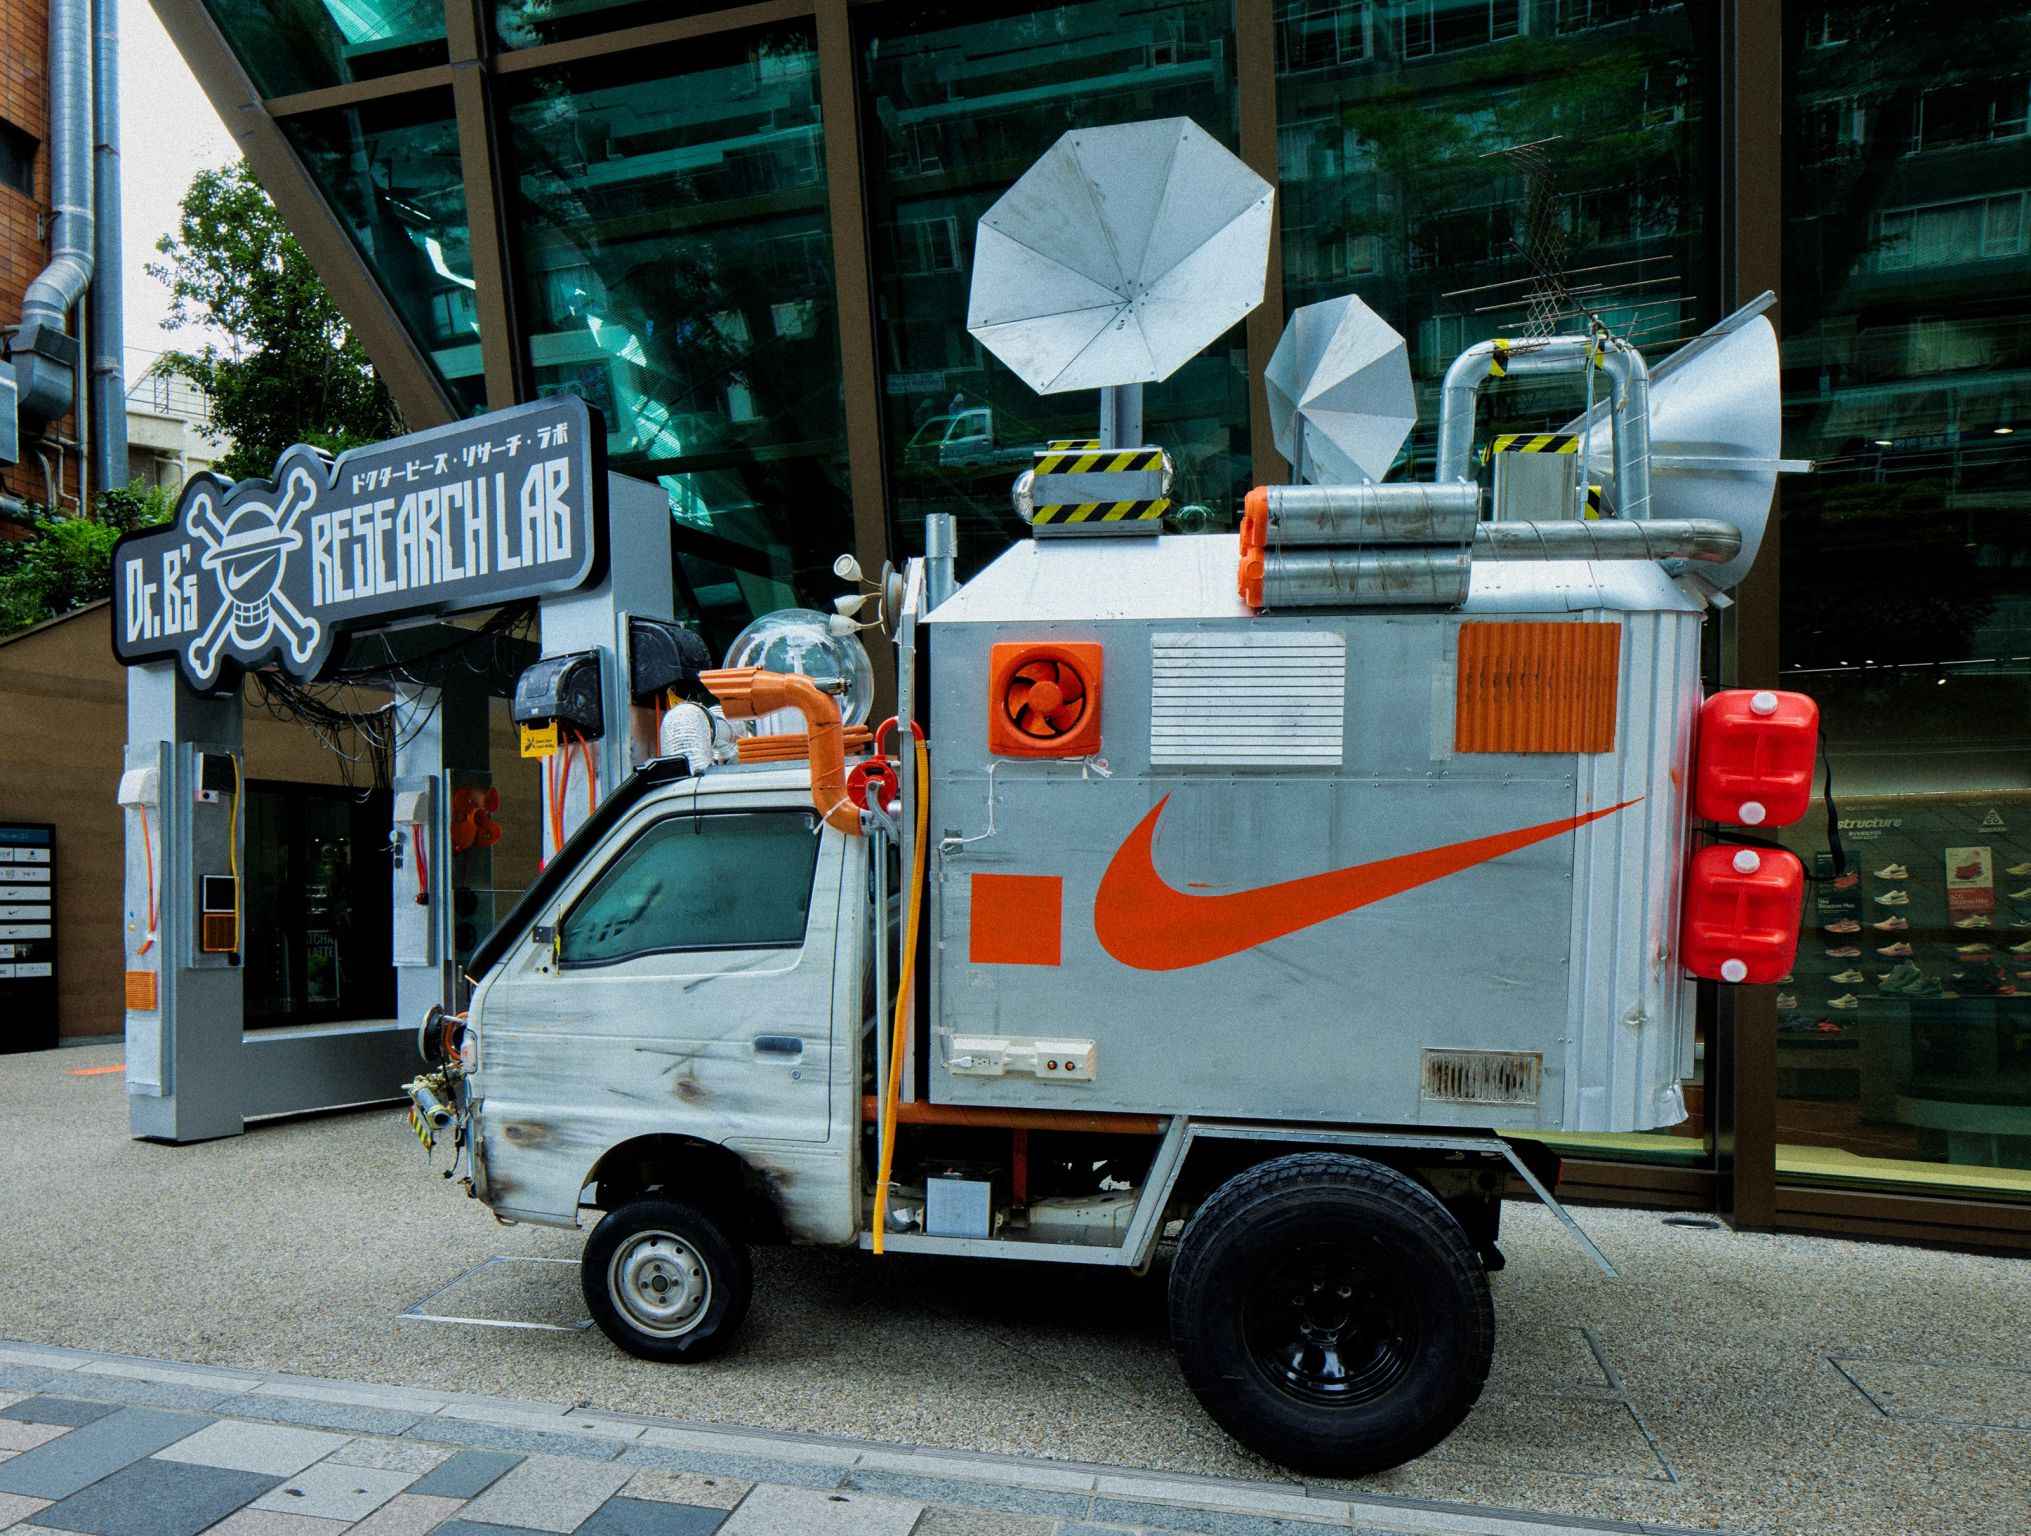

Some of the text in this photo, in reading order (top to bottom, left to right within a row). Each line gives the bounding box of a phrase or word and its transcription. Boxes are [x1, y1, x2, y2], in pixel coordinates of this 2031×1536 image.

[312, 478, 489, 607] RESEARCH
[496, 457, 572, 572] LAB
[1837, 817, 1902, 830] structure
